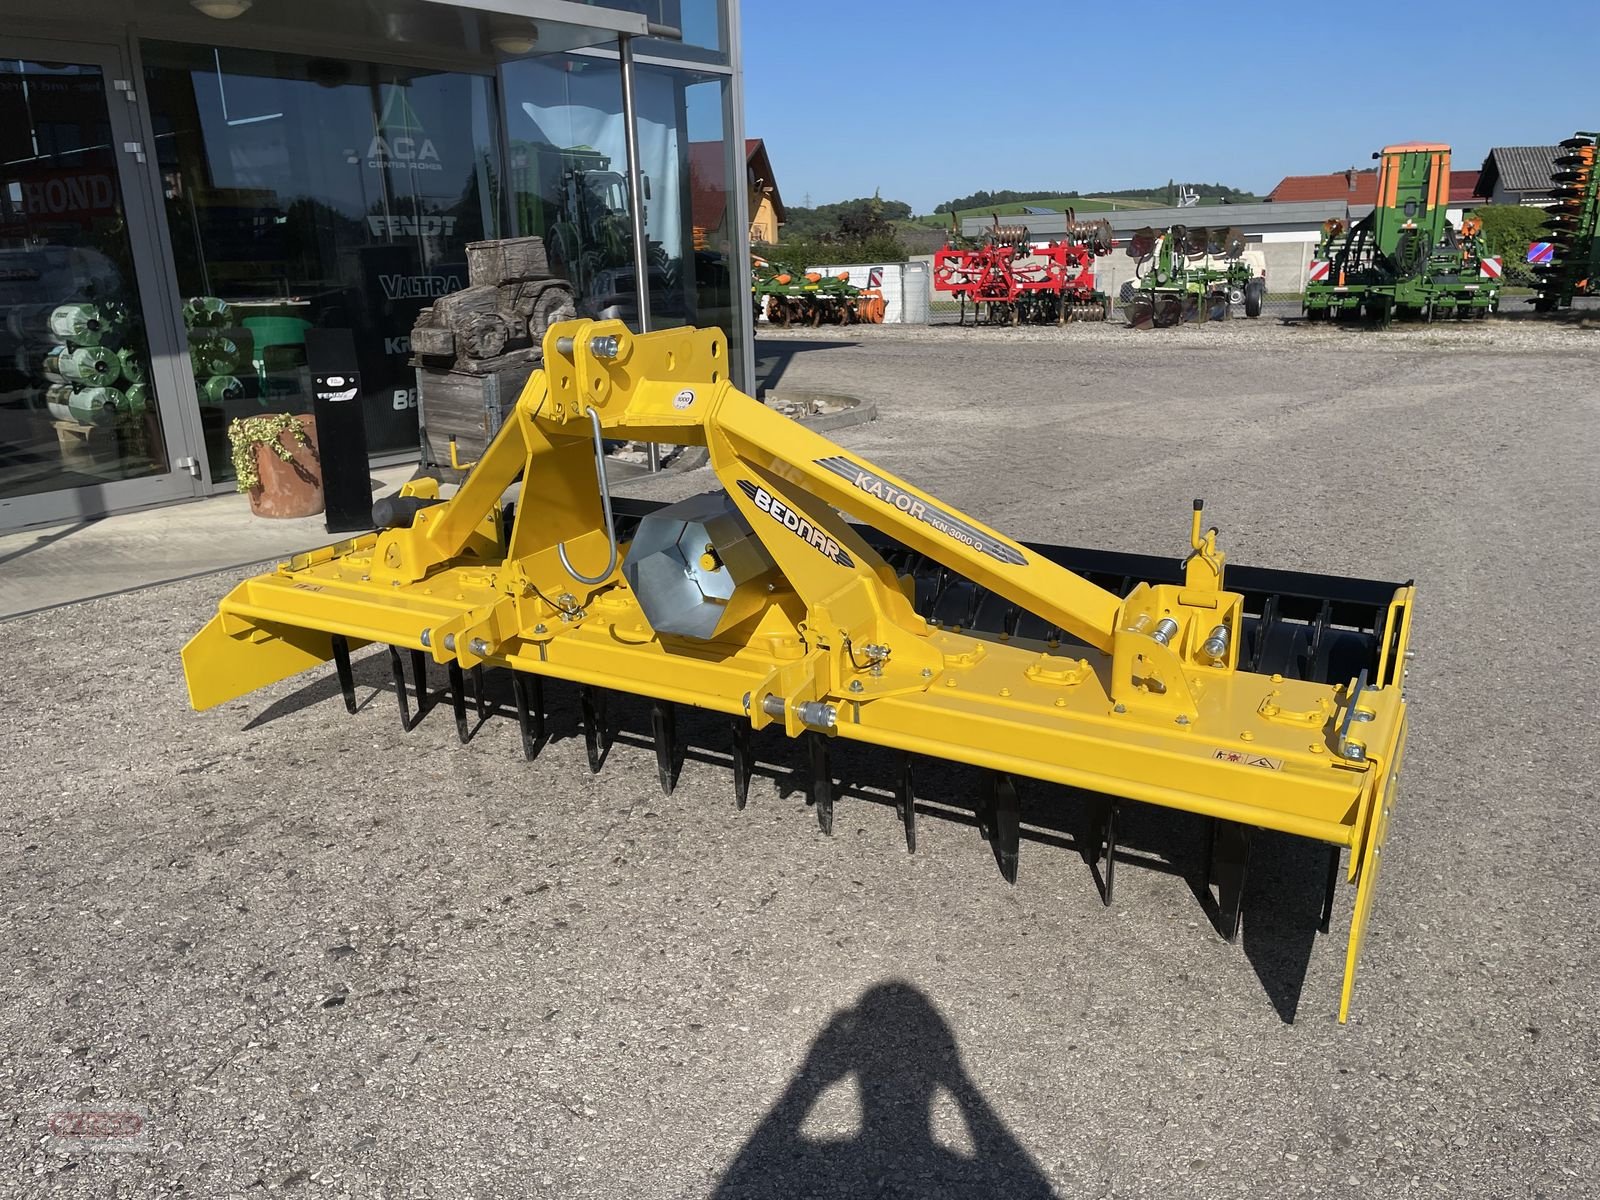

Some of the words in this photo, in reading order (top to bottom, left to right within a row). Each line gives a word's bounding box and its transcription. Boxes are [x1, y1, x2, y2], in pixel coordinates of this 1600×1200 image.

[367, 136, 440, 161] ACA
[368, 160, 406, 169] CENTER
[23, 175, 118, 214] HOND
[366, 215, 457, 237] FENDT
[378, 274, 463, 300] VALTRA
[754, 486, 840, 562] BEDNAR
[854, 471, 926, 520] KATOR
[931, 518, 948, 532] KN
[948, 528, 973, 545] 3000
[974, 541, 983, 551] Q
